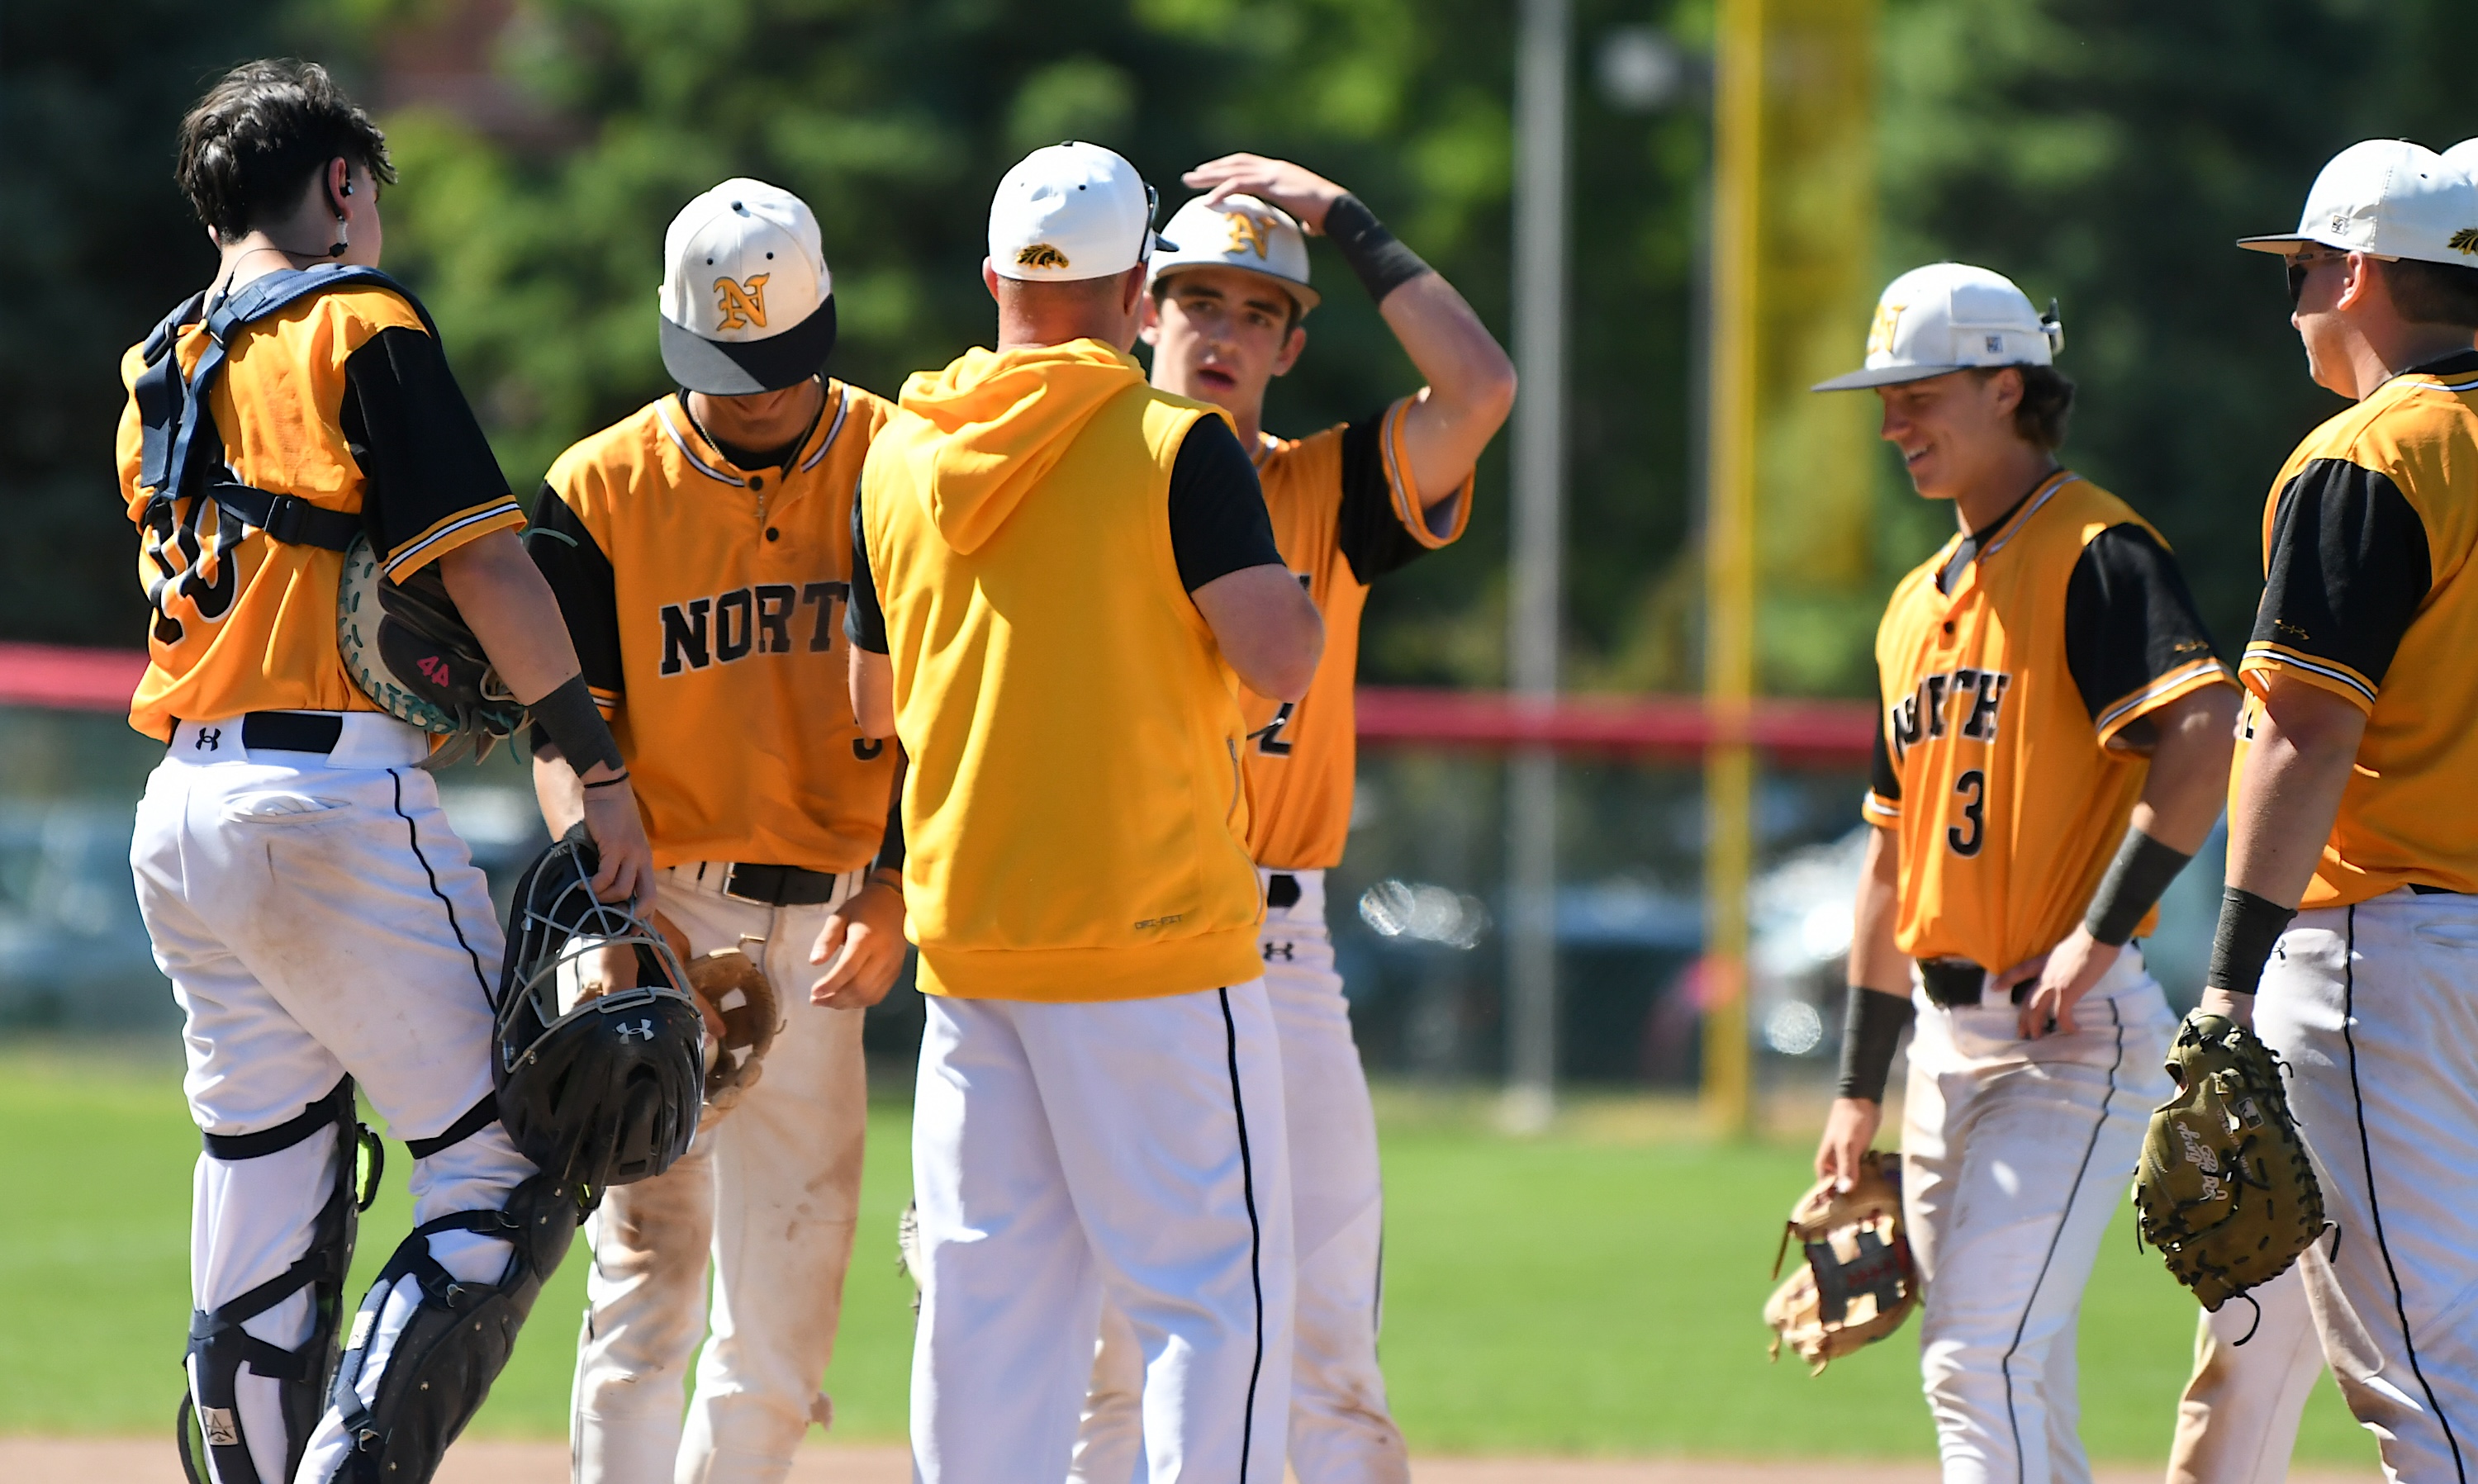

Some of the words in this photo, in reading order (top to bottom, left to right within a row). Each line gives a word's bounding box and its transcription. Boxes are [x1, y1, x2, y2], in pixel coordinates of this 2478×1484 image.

[1222, 211, 1277, 261] N
[713, 272, 770, 331] N
[659, 581, 852, 678] NORT
[1947, 768, 1985, 859] 3
